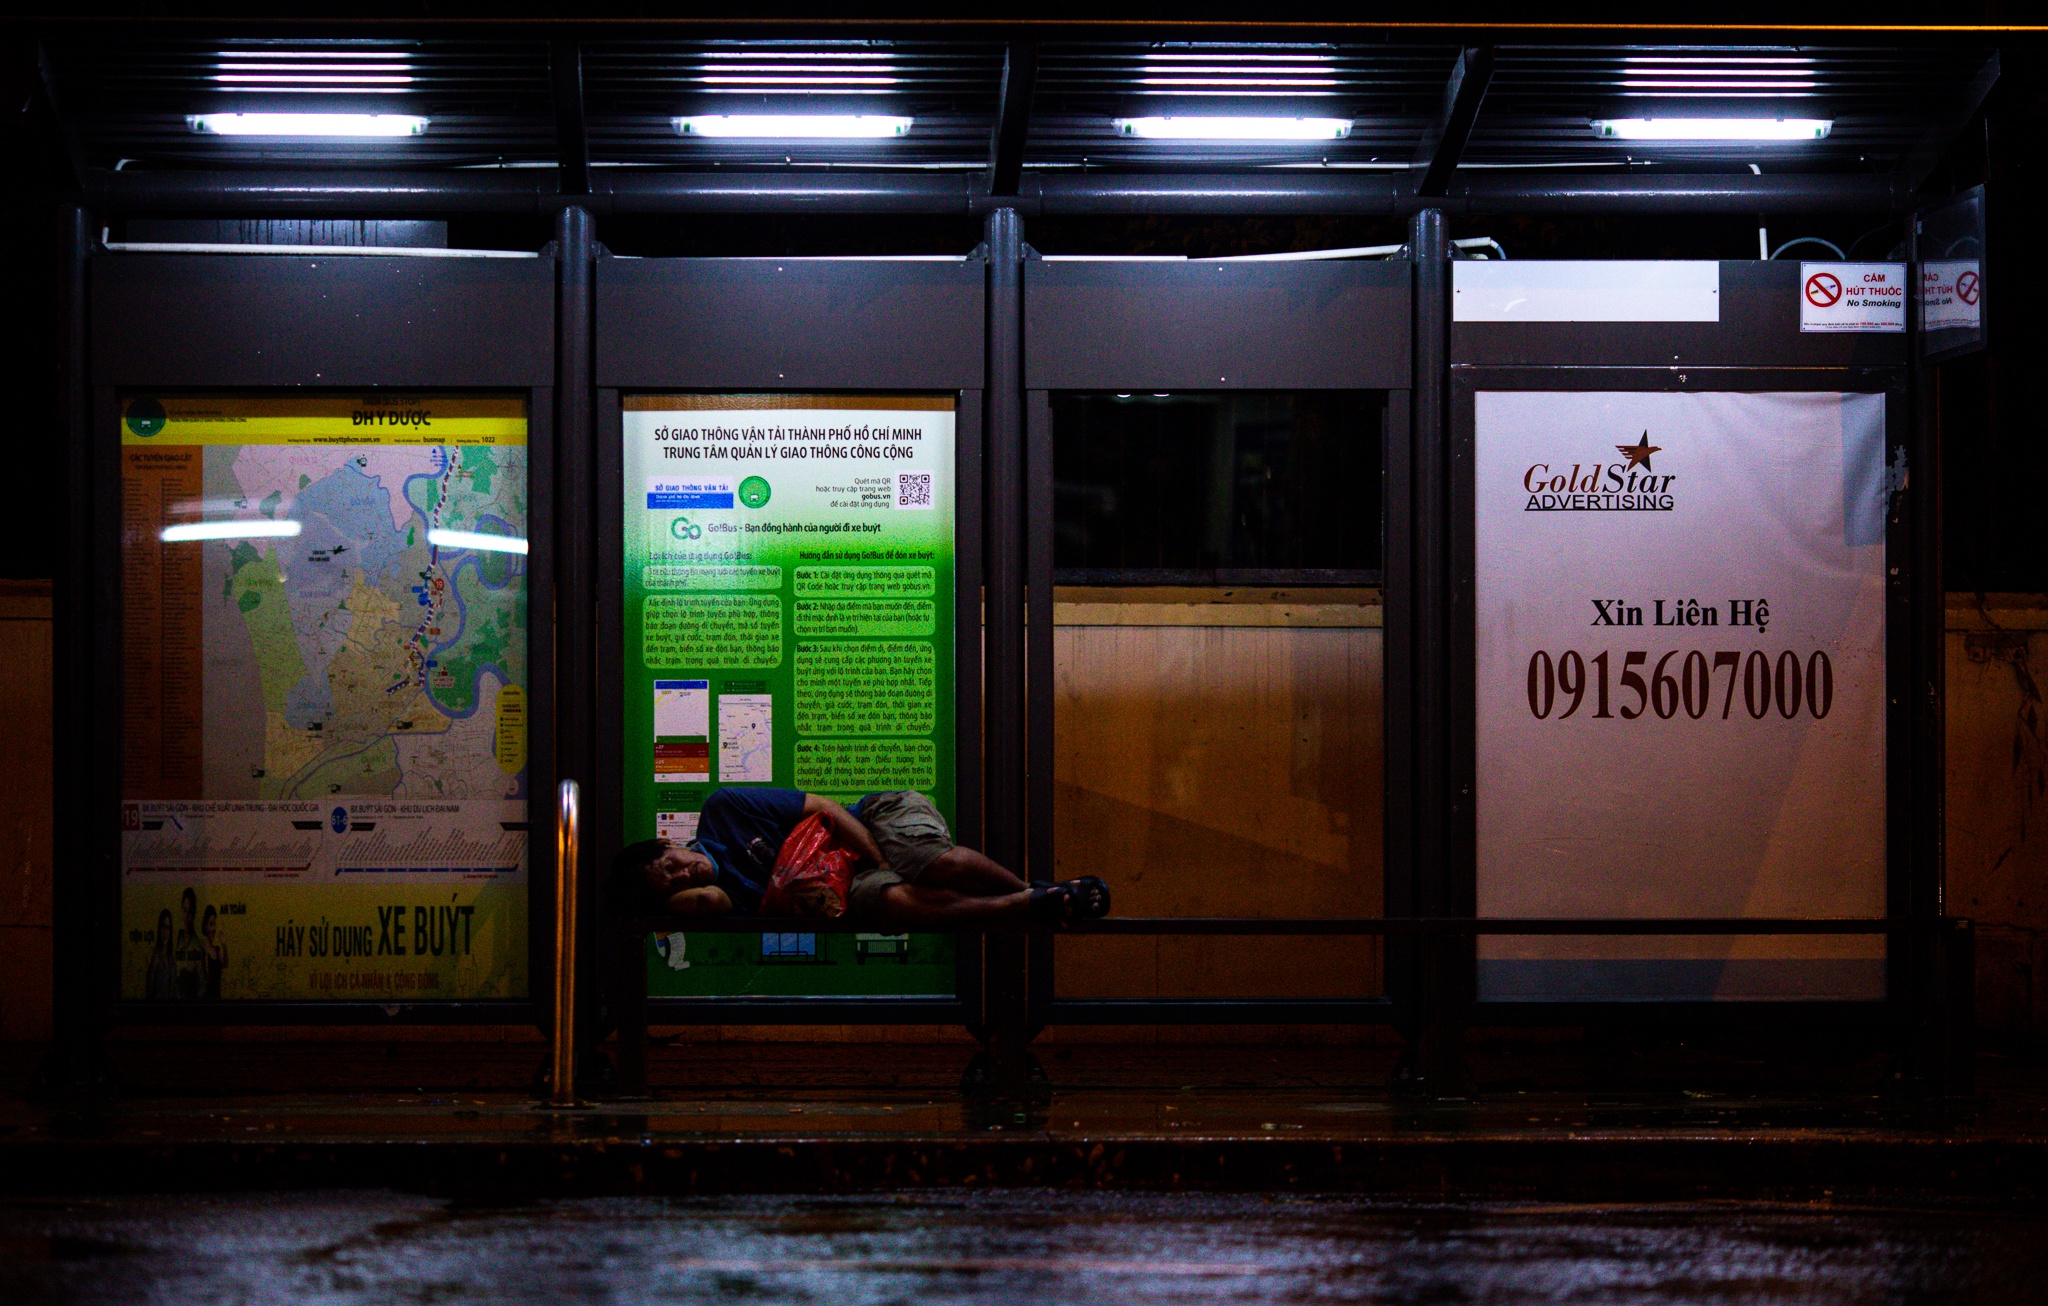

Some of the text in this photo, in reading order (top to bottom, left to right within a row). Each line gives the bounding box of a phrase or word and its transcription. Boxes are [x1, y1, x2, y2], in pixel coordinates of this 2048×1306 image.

[1864, 273, 1886, 282] CẤM
[1846, 285, 1902, 296] HÚT THUỐC
[1862, 300, 1901, 309] Smoking
[352, 409, 432, 430] ĐH Y DƯỢC
[654, 426, 922, 443] SỞ GIAO THÔNG VẬN TẢI THÀNH PHỐ HỒ CHÍ MINH
[663, 444, 913, 461] TRUNG TÂM QUẢN LÝ GIAO THÔNG CÔNG CỘNG
[1523, 463, 1676, 494] GoldStar
[682, 483, 702, 491] THÔNG
[1526, 494, 1674, 509] ADVERTISING
[745, 524, 760, 534] Bạn
[761, 523, 782, 534] đồng
[783, 523, 803, 531] hành
[804, 523, 818, 531] của
[819, 523, 842, 534] người
[862, 523, 882, 534] buýt
[800, 550, 820, 561] Hướng
[822, 550, 834, 559] dẫn
[844, 552, 860, 561] dụng
[886, 550, 894, 559] để
[895, 550, 907, 559] đón
[796, 583, 806, 591] QR
[1590, 598, 1770, 633] Xin Liên Hệ
[1527, 650, 1834, 720] 0915607000
[124, 810, 138, 827] 19
[276, 893, 475, 964] HÃY SỬ DỤNG XE BUÝT
